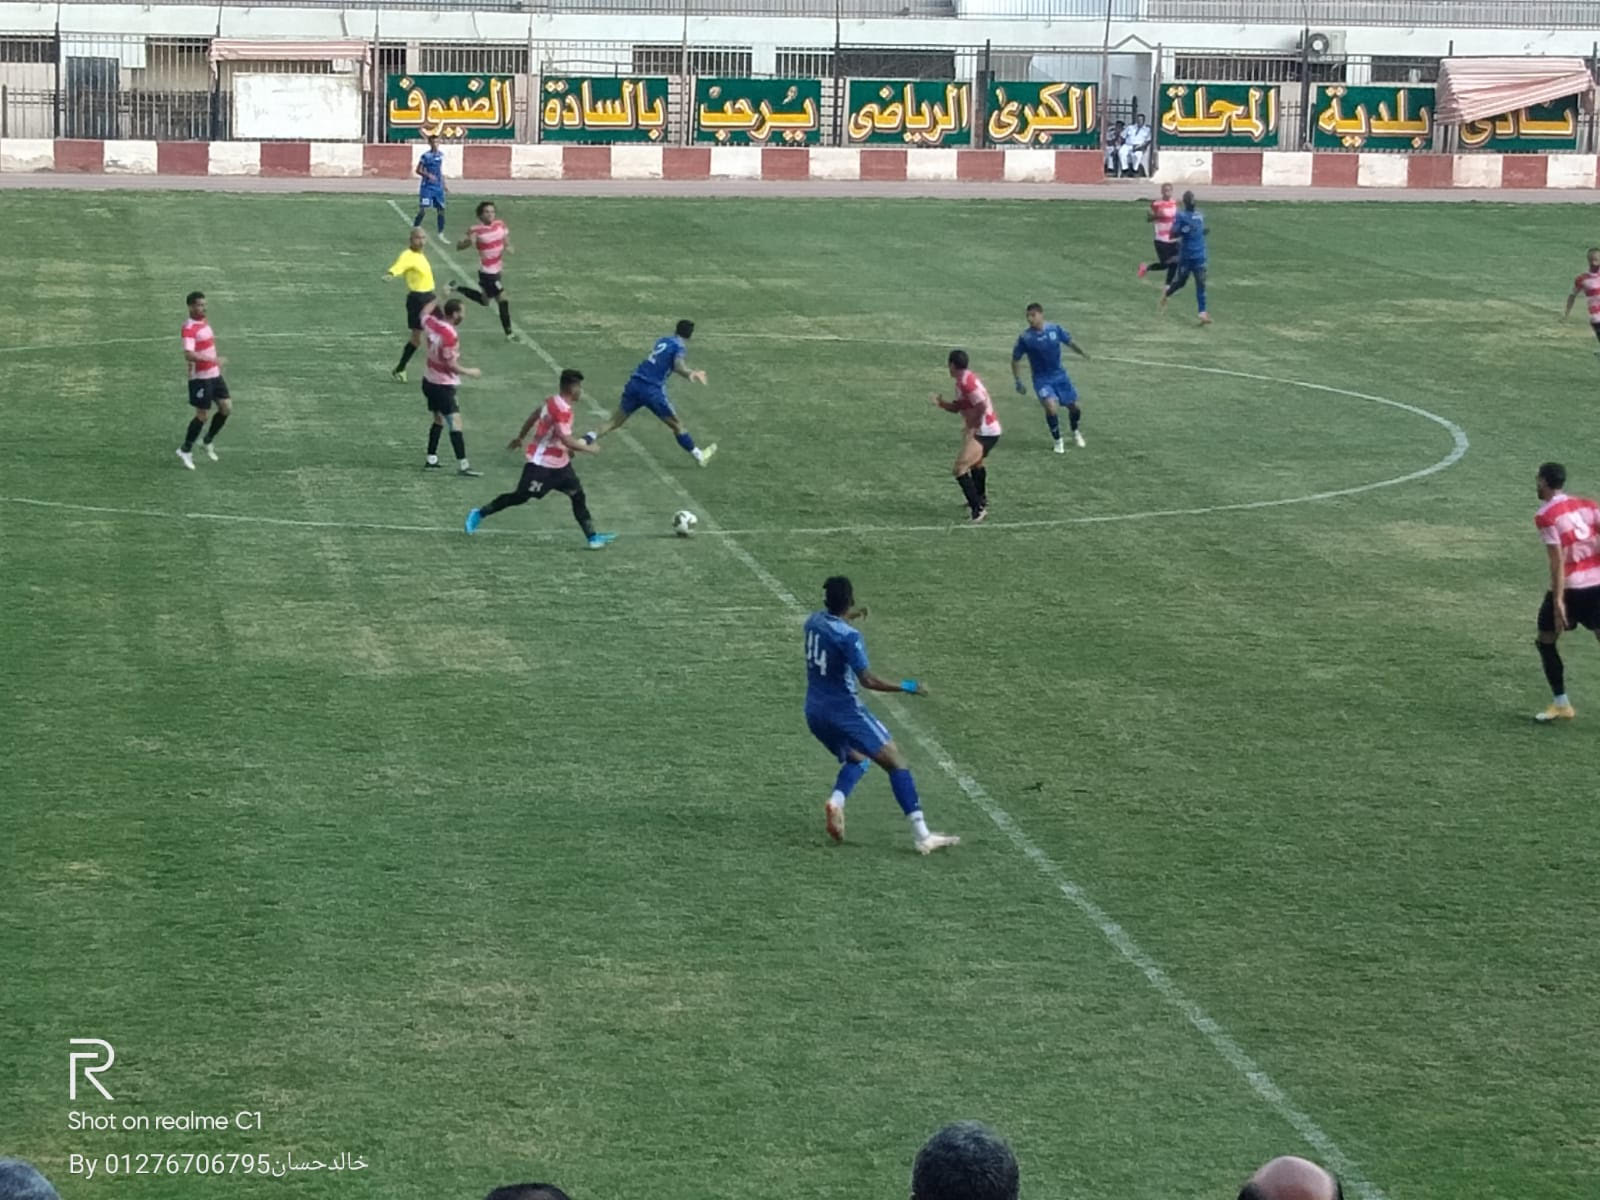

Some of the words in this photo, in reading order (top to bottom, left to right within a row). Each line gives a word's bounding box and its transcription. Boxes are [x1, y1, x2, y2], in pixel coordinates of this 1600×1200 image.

[389, 76, 514, 137] الضيوف
[544, 79, 665, 140] بالسادة
[849, 83, 969, 143] الرياضى
[1162, 86, 1278, 139] المحلة
[1318, 86, 1430, 148] بلدية
[647, 342, 668, 365] 2
[807, 629, 828, 676] 14
